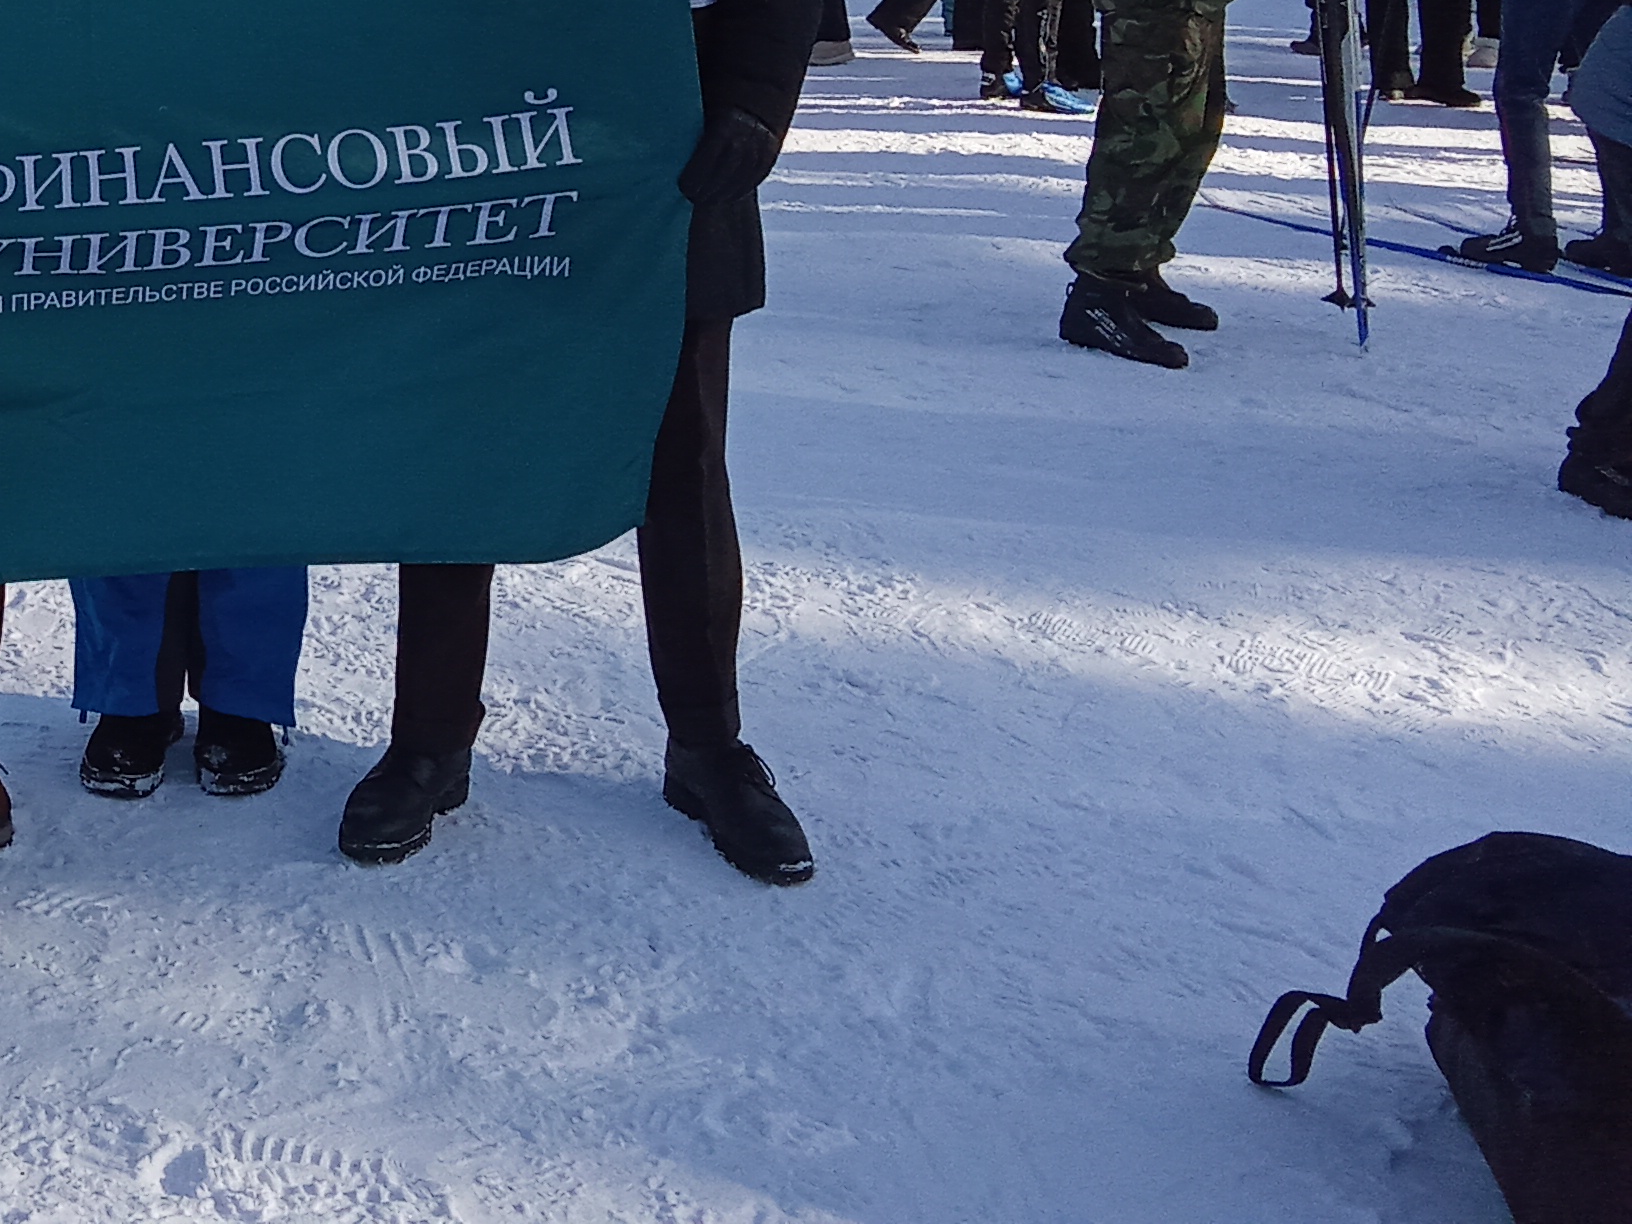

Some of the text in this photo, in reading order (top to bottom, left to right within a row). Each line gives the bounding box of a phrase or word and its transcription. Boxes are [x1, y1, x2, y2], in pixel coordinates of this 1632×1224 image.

[10, 280, 224, 313] ПРАВИТЕЛЬСТВЕ
[230, 264, 405, 296] РОССИЙСКОЙ
[411, 255, 571, 284] ФЕДЕРАЦИИ
